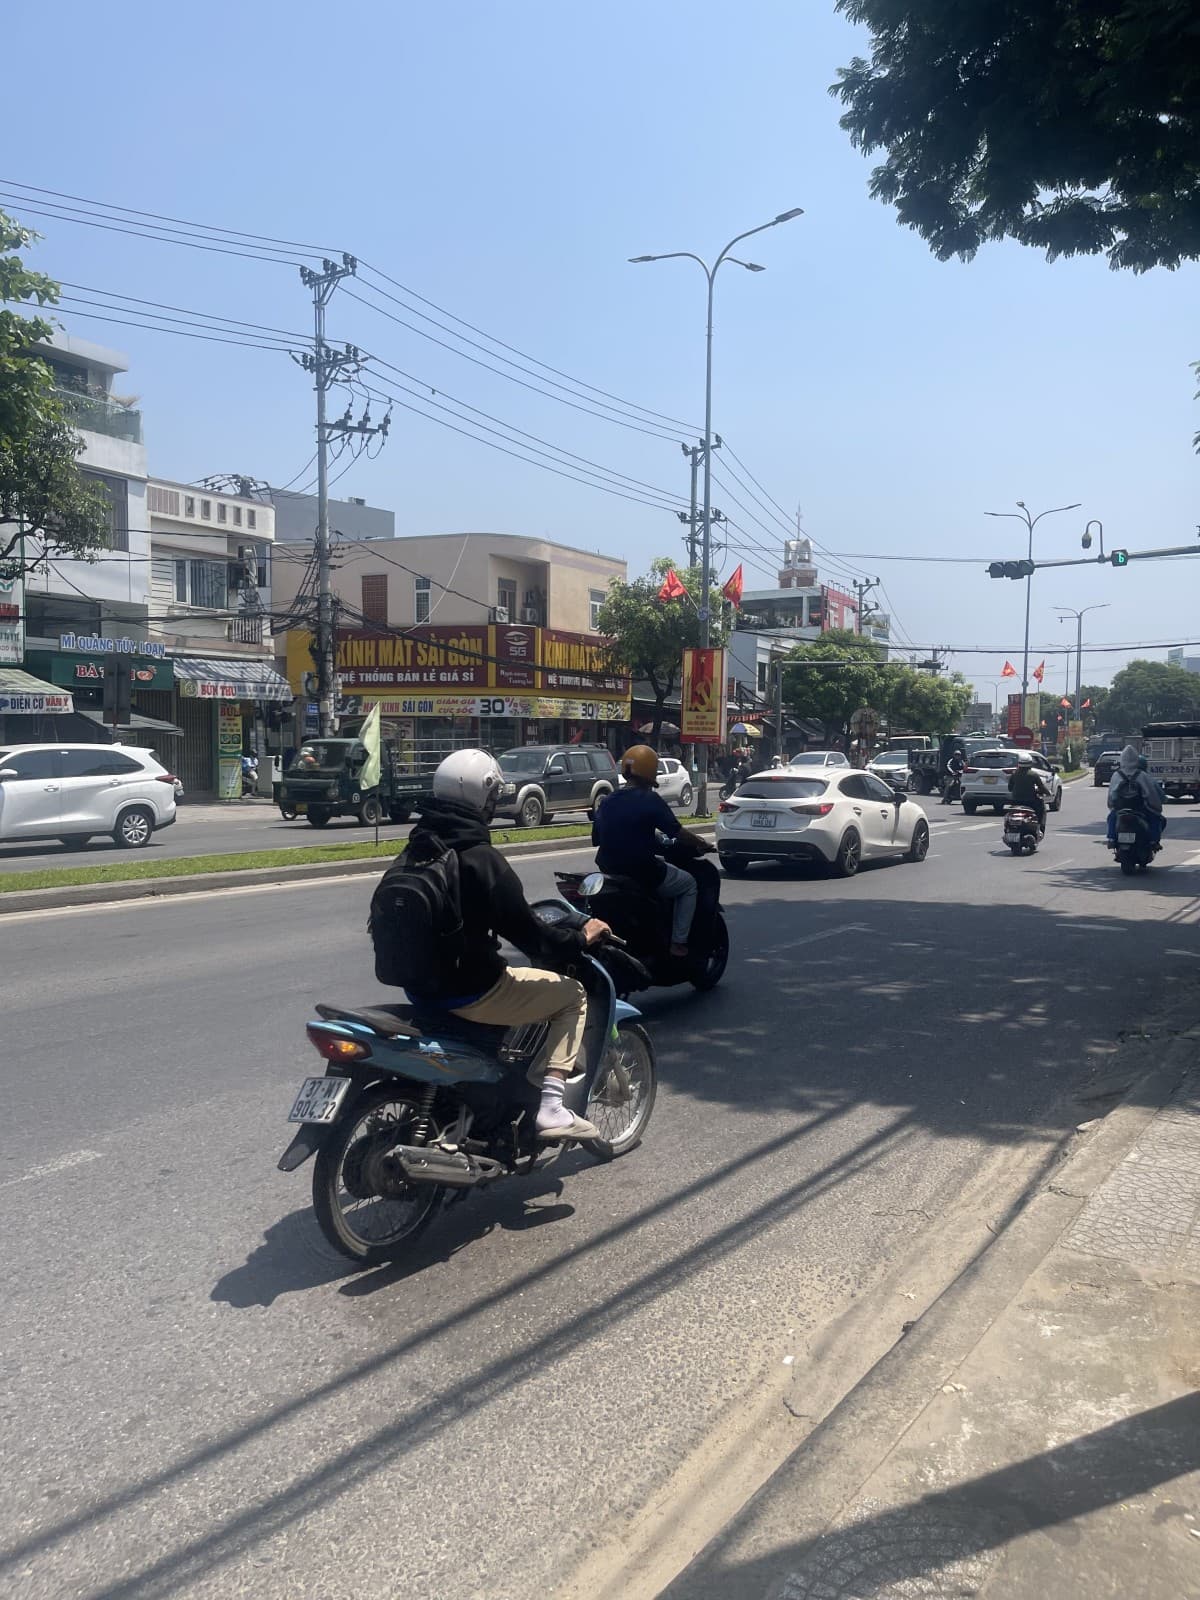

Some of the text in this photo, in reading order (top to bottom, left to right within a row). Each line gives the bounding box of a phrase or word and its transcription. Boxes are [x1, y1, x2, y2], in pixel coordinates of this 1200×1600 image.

[509, 646, 527, 657] SG
[76, 662, 99, 678] BÀ
[397, 669, 420, 682] BÁN
